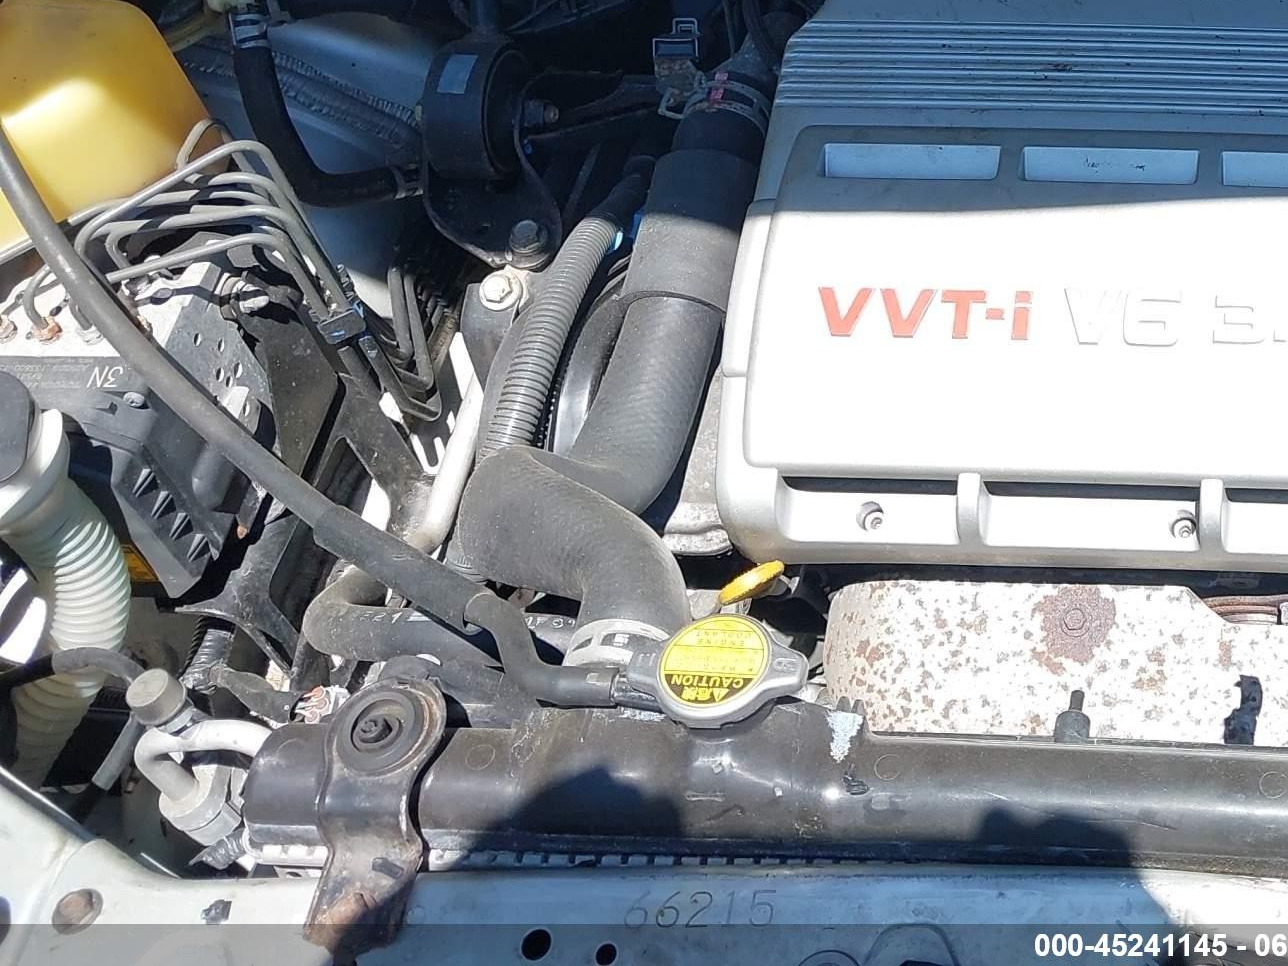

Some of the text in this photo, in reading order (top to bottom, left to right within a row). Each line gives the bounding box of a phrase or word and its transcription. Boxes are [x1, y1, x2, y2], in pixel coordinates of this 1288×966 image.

[817, 285, 1032, 341] VVT-i
[1065, 286, 1181, 347] V6
[86, 365, 124, 389] 3N
[671, 674, 744, 689] CAUTION
[623, 888, 778, 929] 66215
